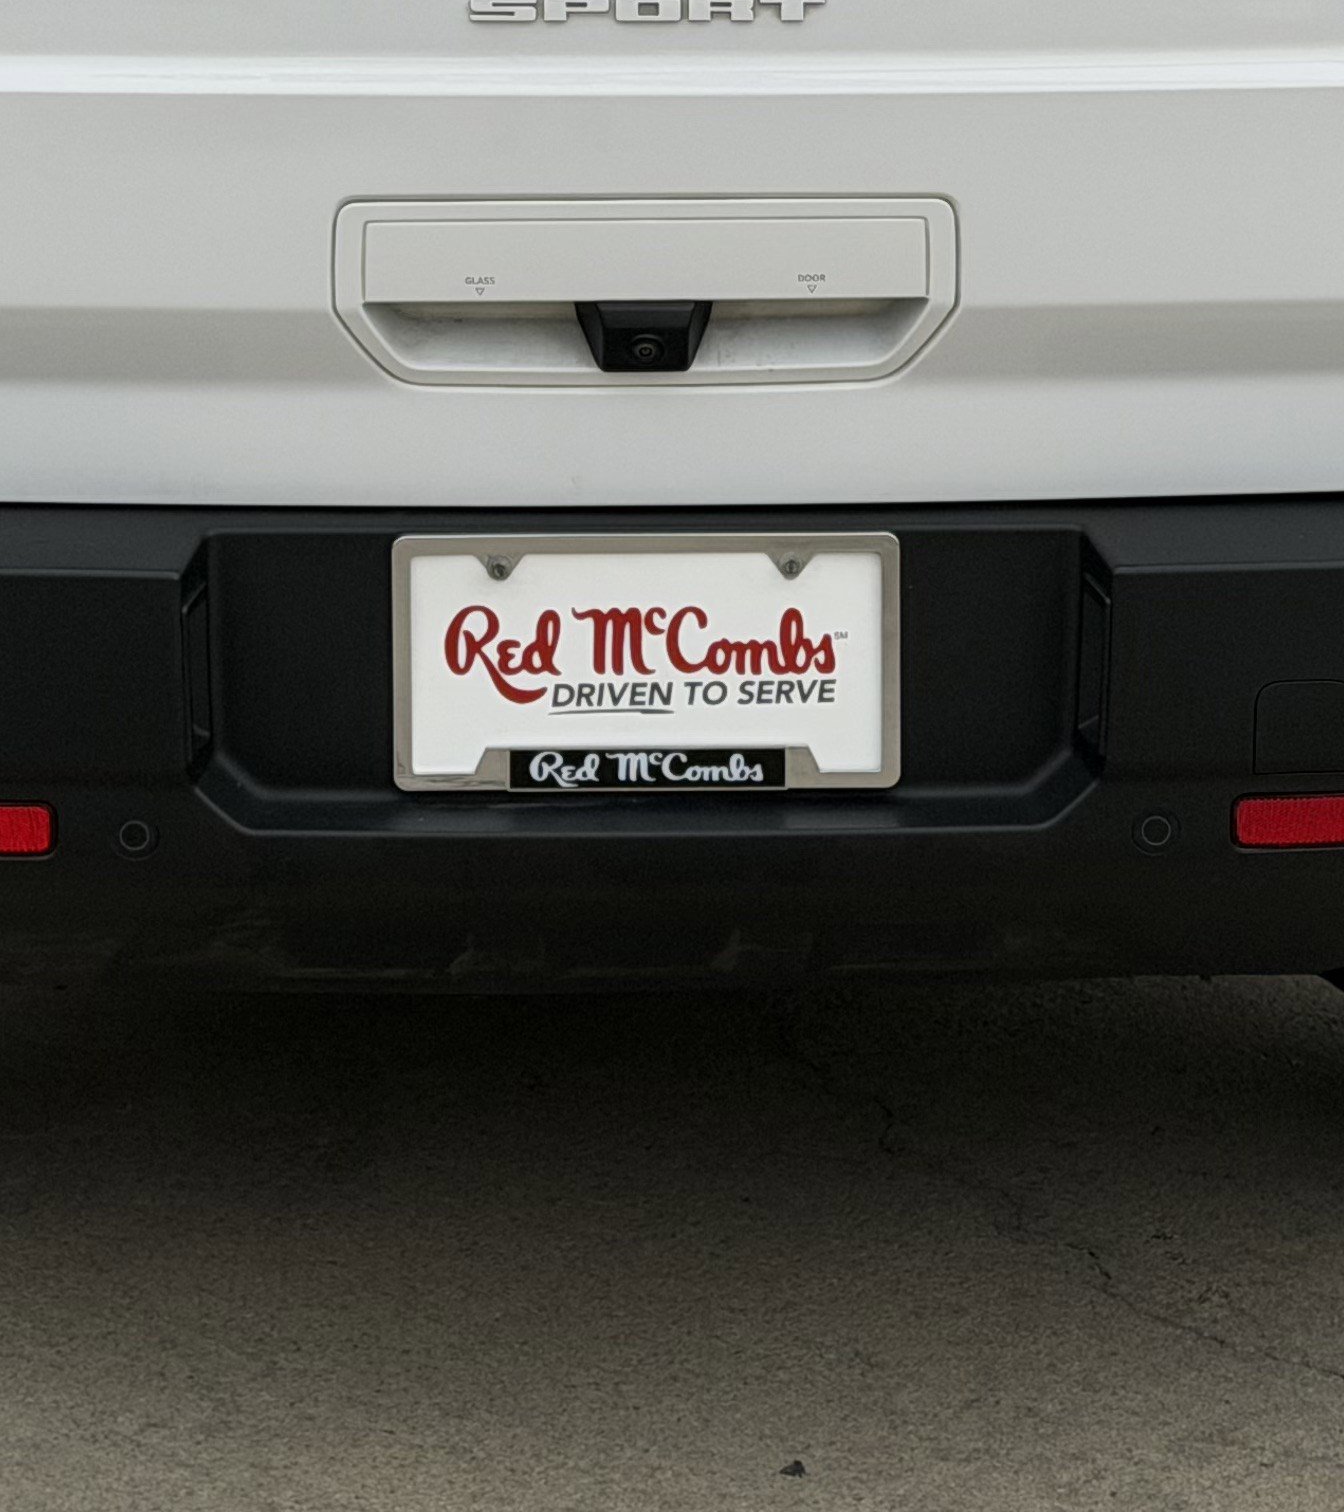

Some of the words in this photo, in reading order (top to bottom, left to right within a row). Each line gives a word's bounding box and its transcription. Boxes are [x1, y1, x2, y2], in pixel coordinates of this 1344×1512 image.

[464, 275, 496, 286] GLASS
[797, 272, 827, 284] DOOR
[444, 604, 563, 704] Red
[571, 605, 837, 676] McCombs
[551, 681, 674, 708] DRIVEN
[685, 680, 729, 707] TO
[736, 678, 838, 706] SERVE
[529, 750, 601, 788] Red
[605, 750, 765, 783] McCombs
